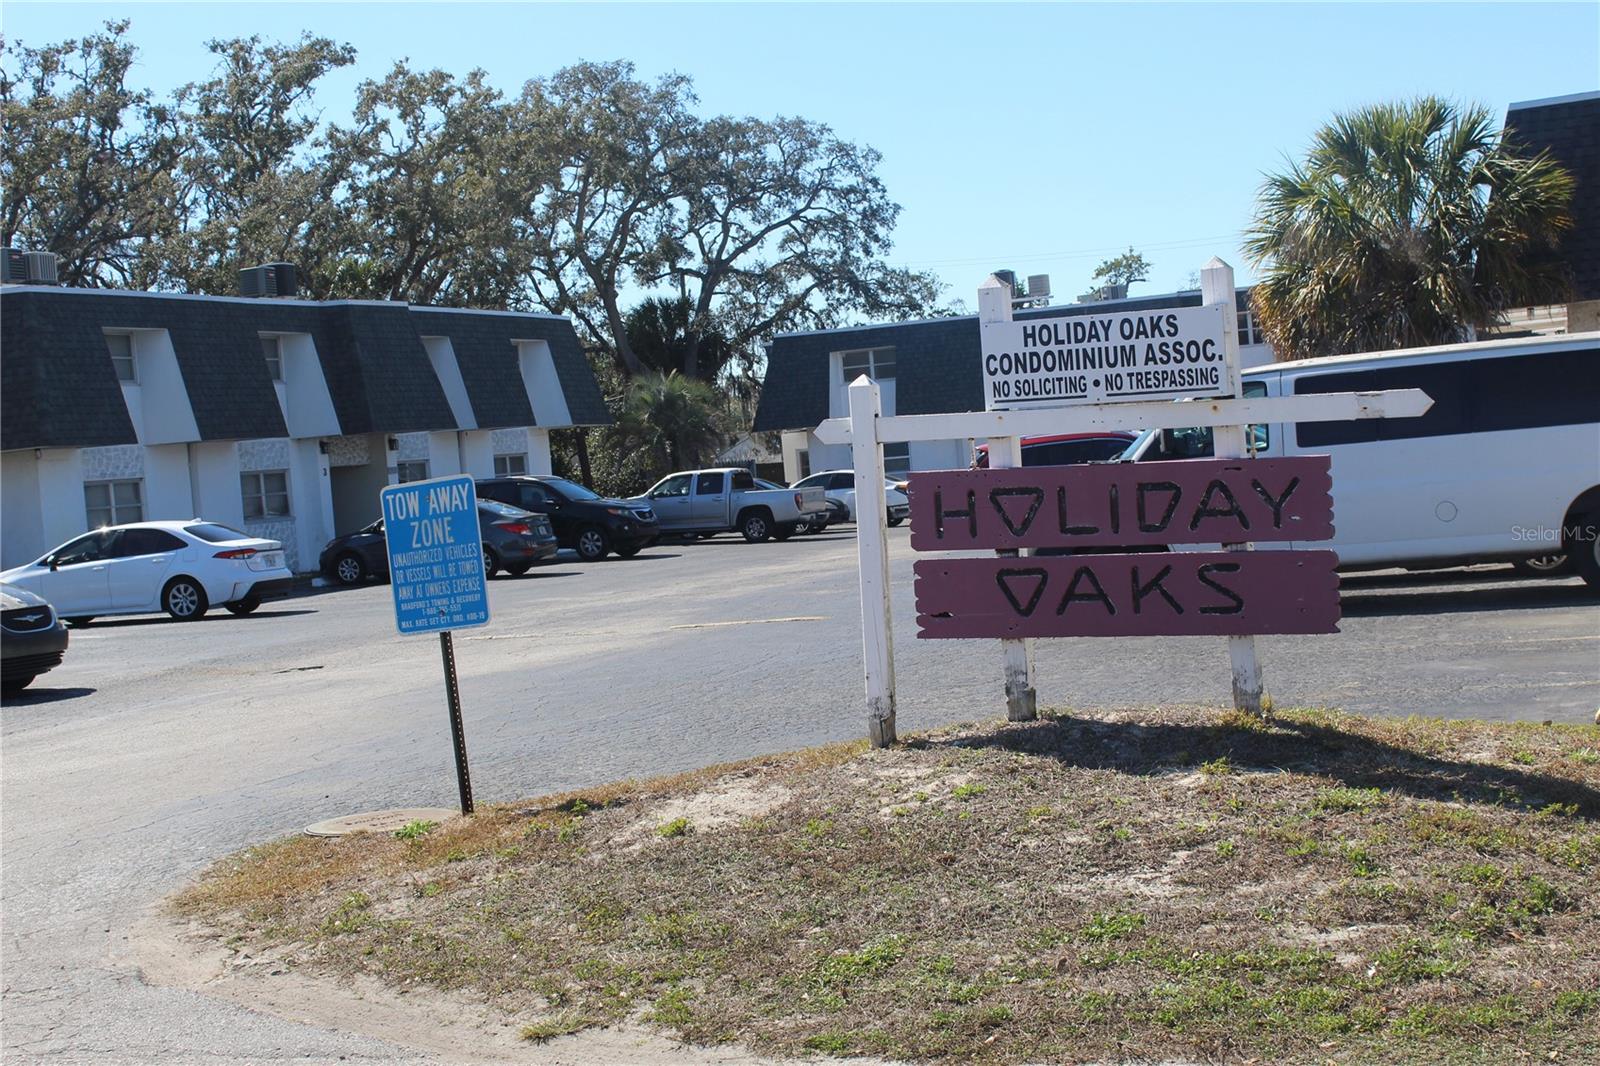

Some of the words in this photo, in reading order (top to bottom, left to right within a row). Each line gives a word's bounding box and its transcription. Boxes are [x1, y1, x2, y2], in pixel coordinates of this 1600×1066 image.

[1022, 319, 1113, 348] HOLIDAY
[1119, 313, 1179, 341] OAKS
[985, 344, 1137, 377] CONDOMINIUM
[1144, 338, 1224, 366] ASSOC.
[992, 380, 1011, 398] NO
[1014, 374, 1088, 397] SOLICITING
[1105, 373, 1123, 392] NO
[1127, 366, 1220, 390] TRESPASSING
[386, 491, 420, 521] TOW
[428, 484, 469, 516] AWAY
[934, 475, 1300, 540] HOLIDAY
[410, 517, 455, 548] ZONE
[392, 548, 443, 568] UNAUTHORIZED
[445, 543, 478, 560] VEHICLES
[396, 571, 405, 584] OR
[405, 567, 432, 583] VESSELS
[432, 565, 447, 579] WILL
[448, 563, 457, 577] BE
[458, 560, 479, 575] TOWED
[399, 587, 414, 600] AWAY
[416, 584, 423, 598] AT
[425, 581, 451, 597] OWNERS
[453, 577, 481, 594] EXPENSE
[450, 596, 456, 604] &
[456, 593, 481, 604] RECOVERY
[996, 562, 1245, 617] OAKS
[415, 618, 429, 627] RATE
[429, 617, 439, 625] SET
